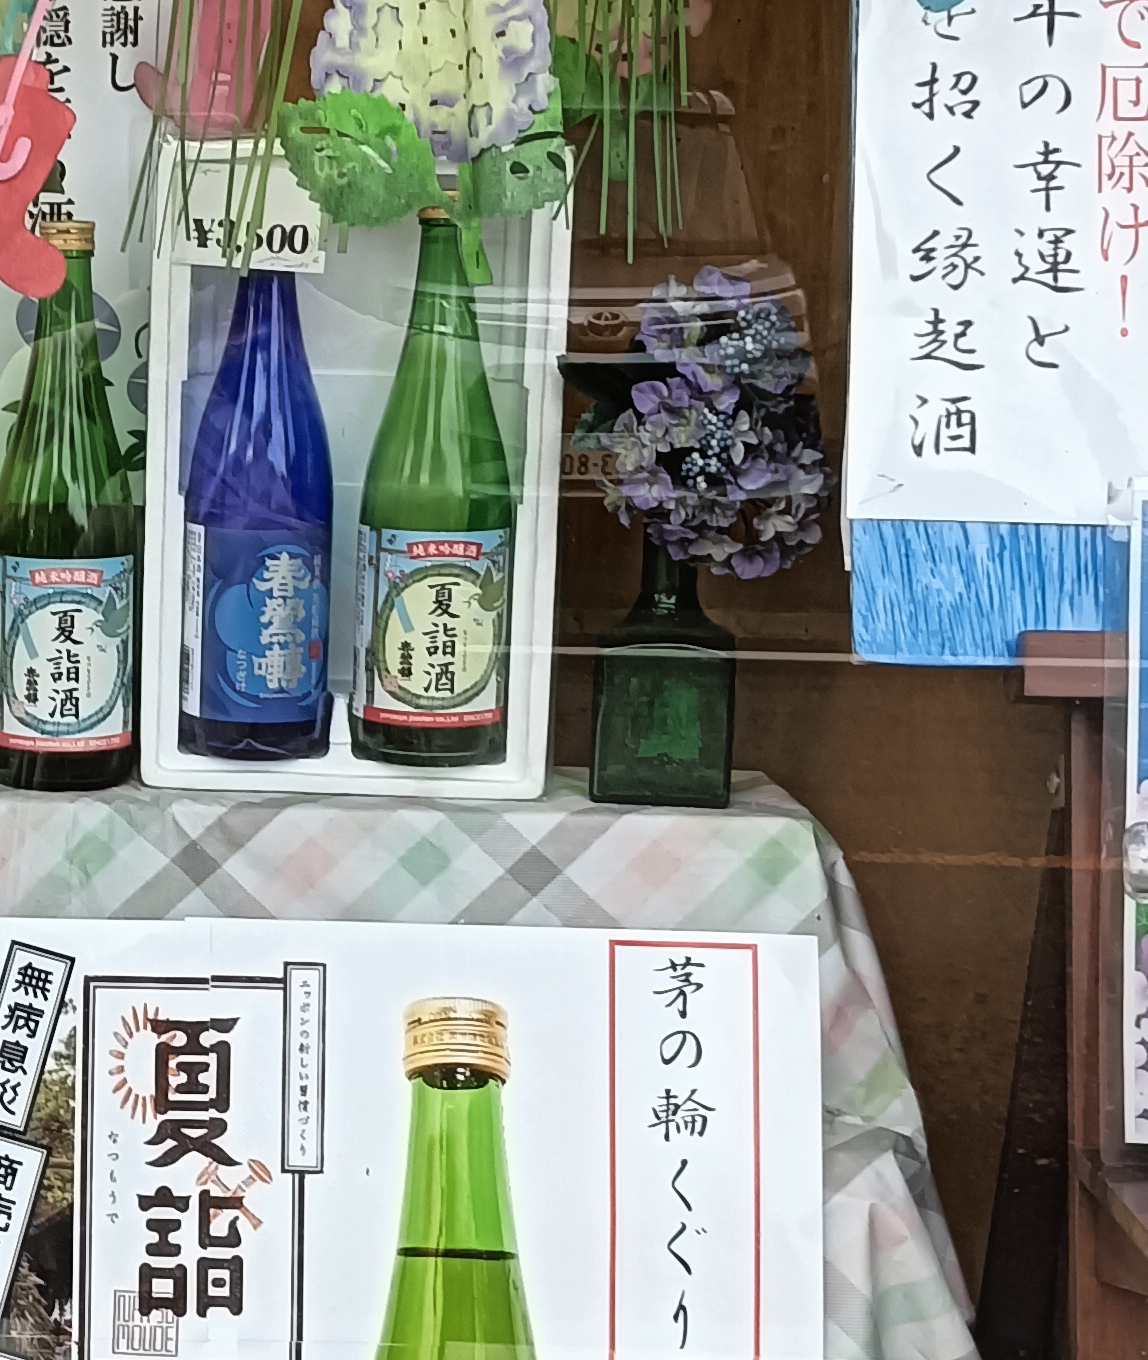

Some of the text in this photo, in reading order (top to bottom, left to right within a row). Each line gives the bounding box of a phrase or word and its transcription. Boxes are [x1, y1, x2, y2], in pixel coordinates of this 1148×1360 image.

[46, 607, 85, 721] 夏詣酒
[252, 550, 312, 690] 春鶯囀
[420, 581, 461, 696] 夏詣酒
[136, 1016, 245, 1319] 夏詣
